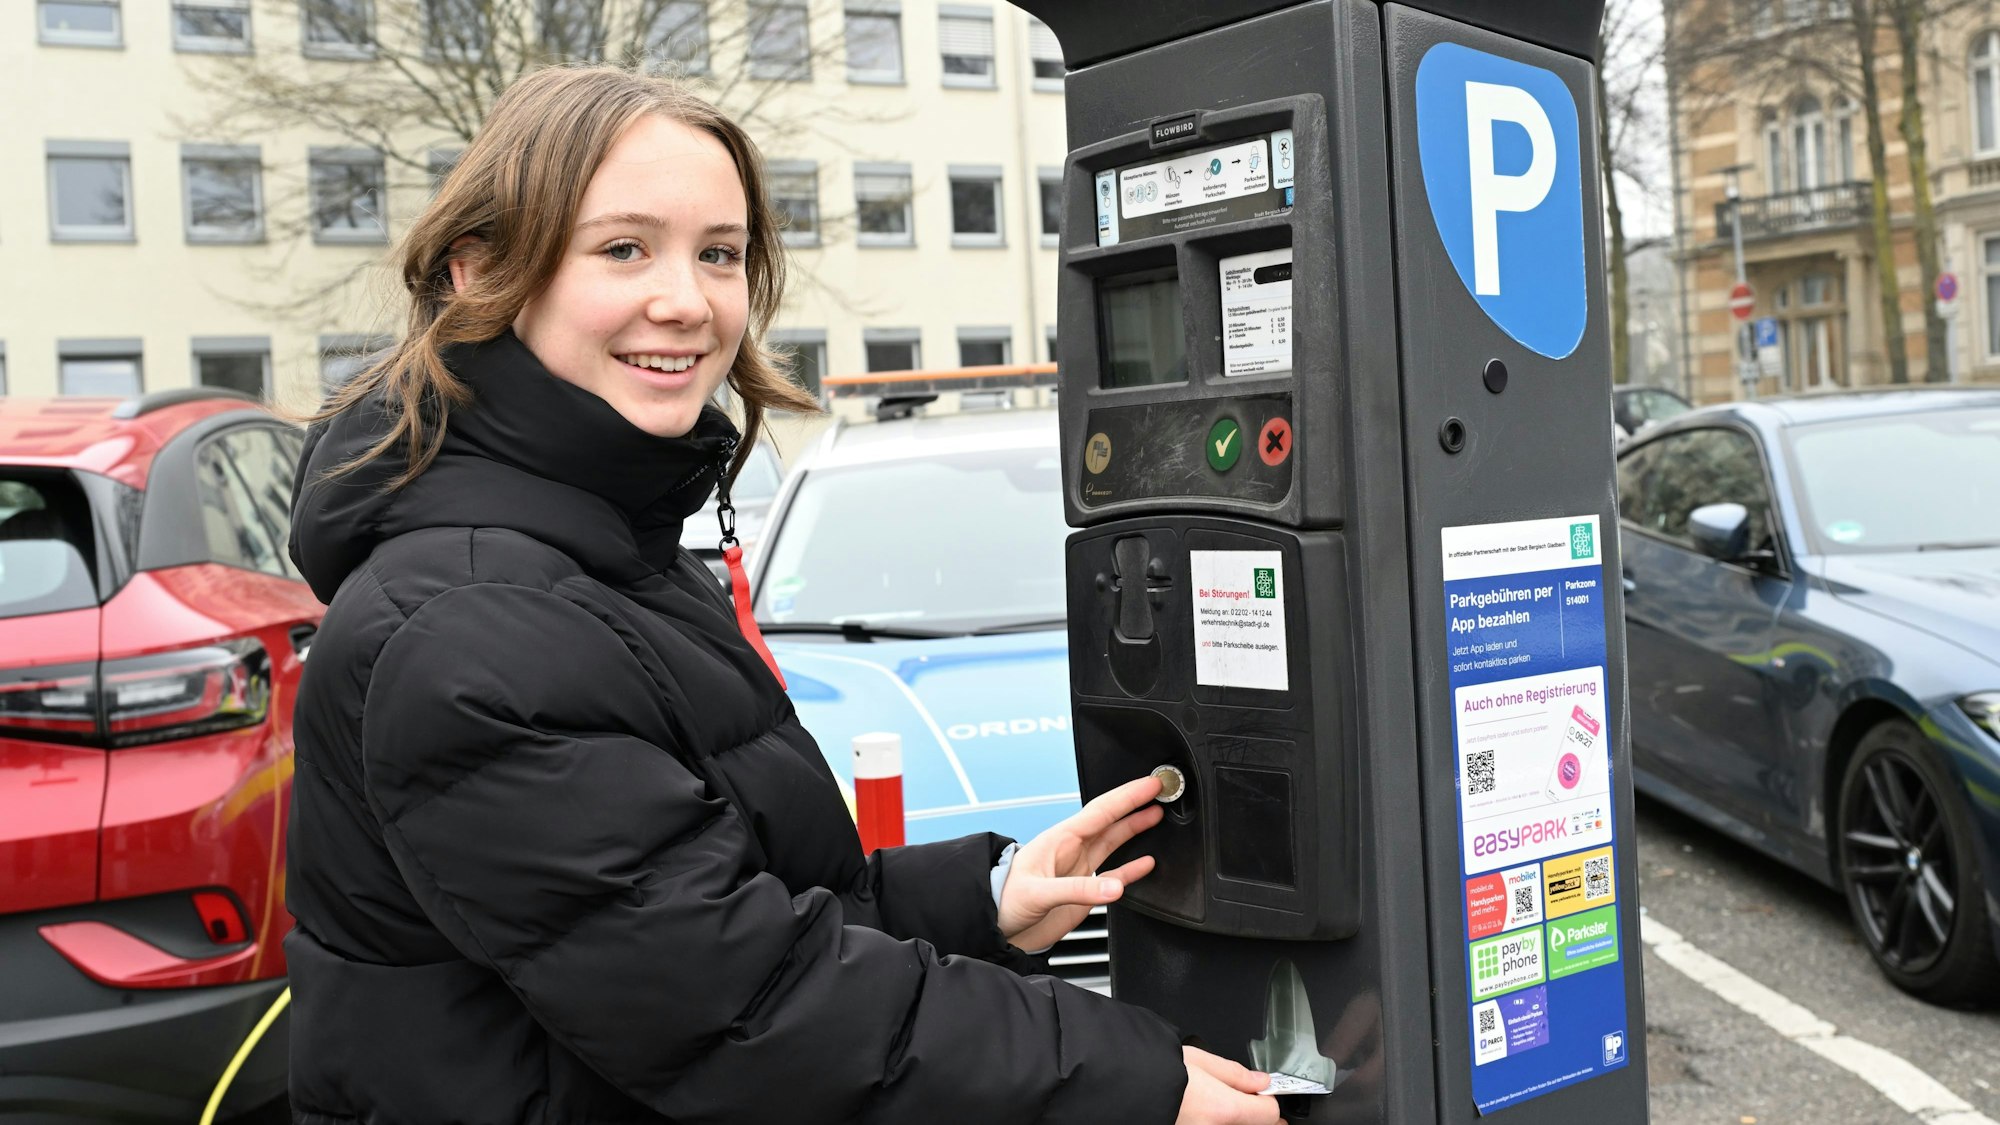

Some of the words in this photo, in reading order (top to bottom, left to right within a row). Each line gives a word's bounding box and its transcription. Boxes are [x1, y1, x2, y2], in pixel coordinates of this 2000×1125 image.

[1156, 122, 1194, 138] FLOWBIRD
[1466, 81, 1556, 296] P
[1454, 550, 1473, 558] offizieller
[1473, 548, 1501, 556] Partnerschaft
[1528, 543, 1546, 551] Bergisch
[1547, 541, 1566, 549] Gladbach
[1565, 578, 1596, 590] Parkzone
[1199, 589, 1210, 598] Bei
[1212, 588, 1250, 601] Störungen!
[1450, 587, 1532, 609] Parkgebühren
[1534, 586, 1554, 602] per
[1566, 595, 1590, 606] 514001
[1200, 608, 1221, 617] Meldung
[1201, 618, 1270, 629] verkehrstechnik@stadt-gl.de
[1451, 617, 1475, 634] App
[1478, 609, 1530, 629] bezahlen
[1202, 640, 1211, 648] und
[1223, 641, 1254, 649] Parkscheibe
[1255, 643, 1279, 652] auslegen.
[1452, 646, 1469, 657] Jetzt
[1470, 644, 1484, 655] App
[1485, 641, 1503, 652] laden
[1504, 639, 1518, 649] und
[1453, 662, 1473, 673] sofort
[1474, 657, 1508, 669] kontaktlos
[1508, 653, 1531, 666] parken
[1464, 696, 1493, 713] Auch
[1496, 693, 1524, 708] ohne
[1526, 681, 1597, 704] Registrierung
[947, 715, 1072, 740] ORDN
[1509, 870, 1537, 885] mobilet
[1471, 894, 1505, 908] Handyparken
[1471, 908, 1482, 917] und
[1567, 921, 1609, 943] Parkster
[1502, 953, 1538, 976] phone
[1480, 972, 1539, 993] www.paybyphone.com
[1488, 1036, 1503, 1045] PARCO
